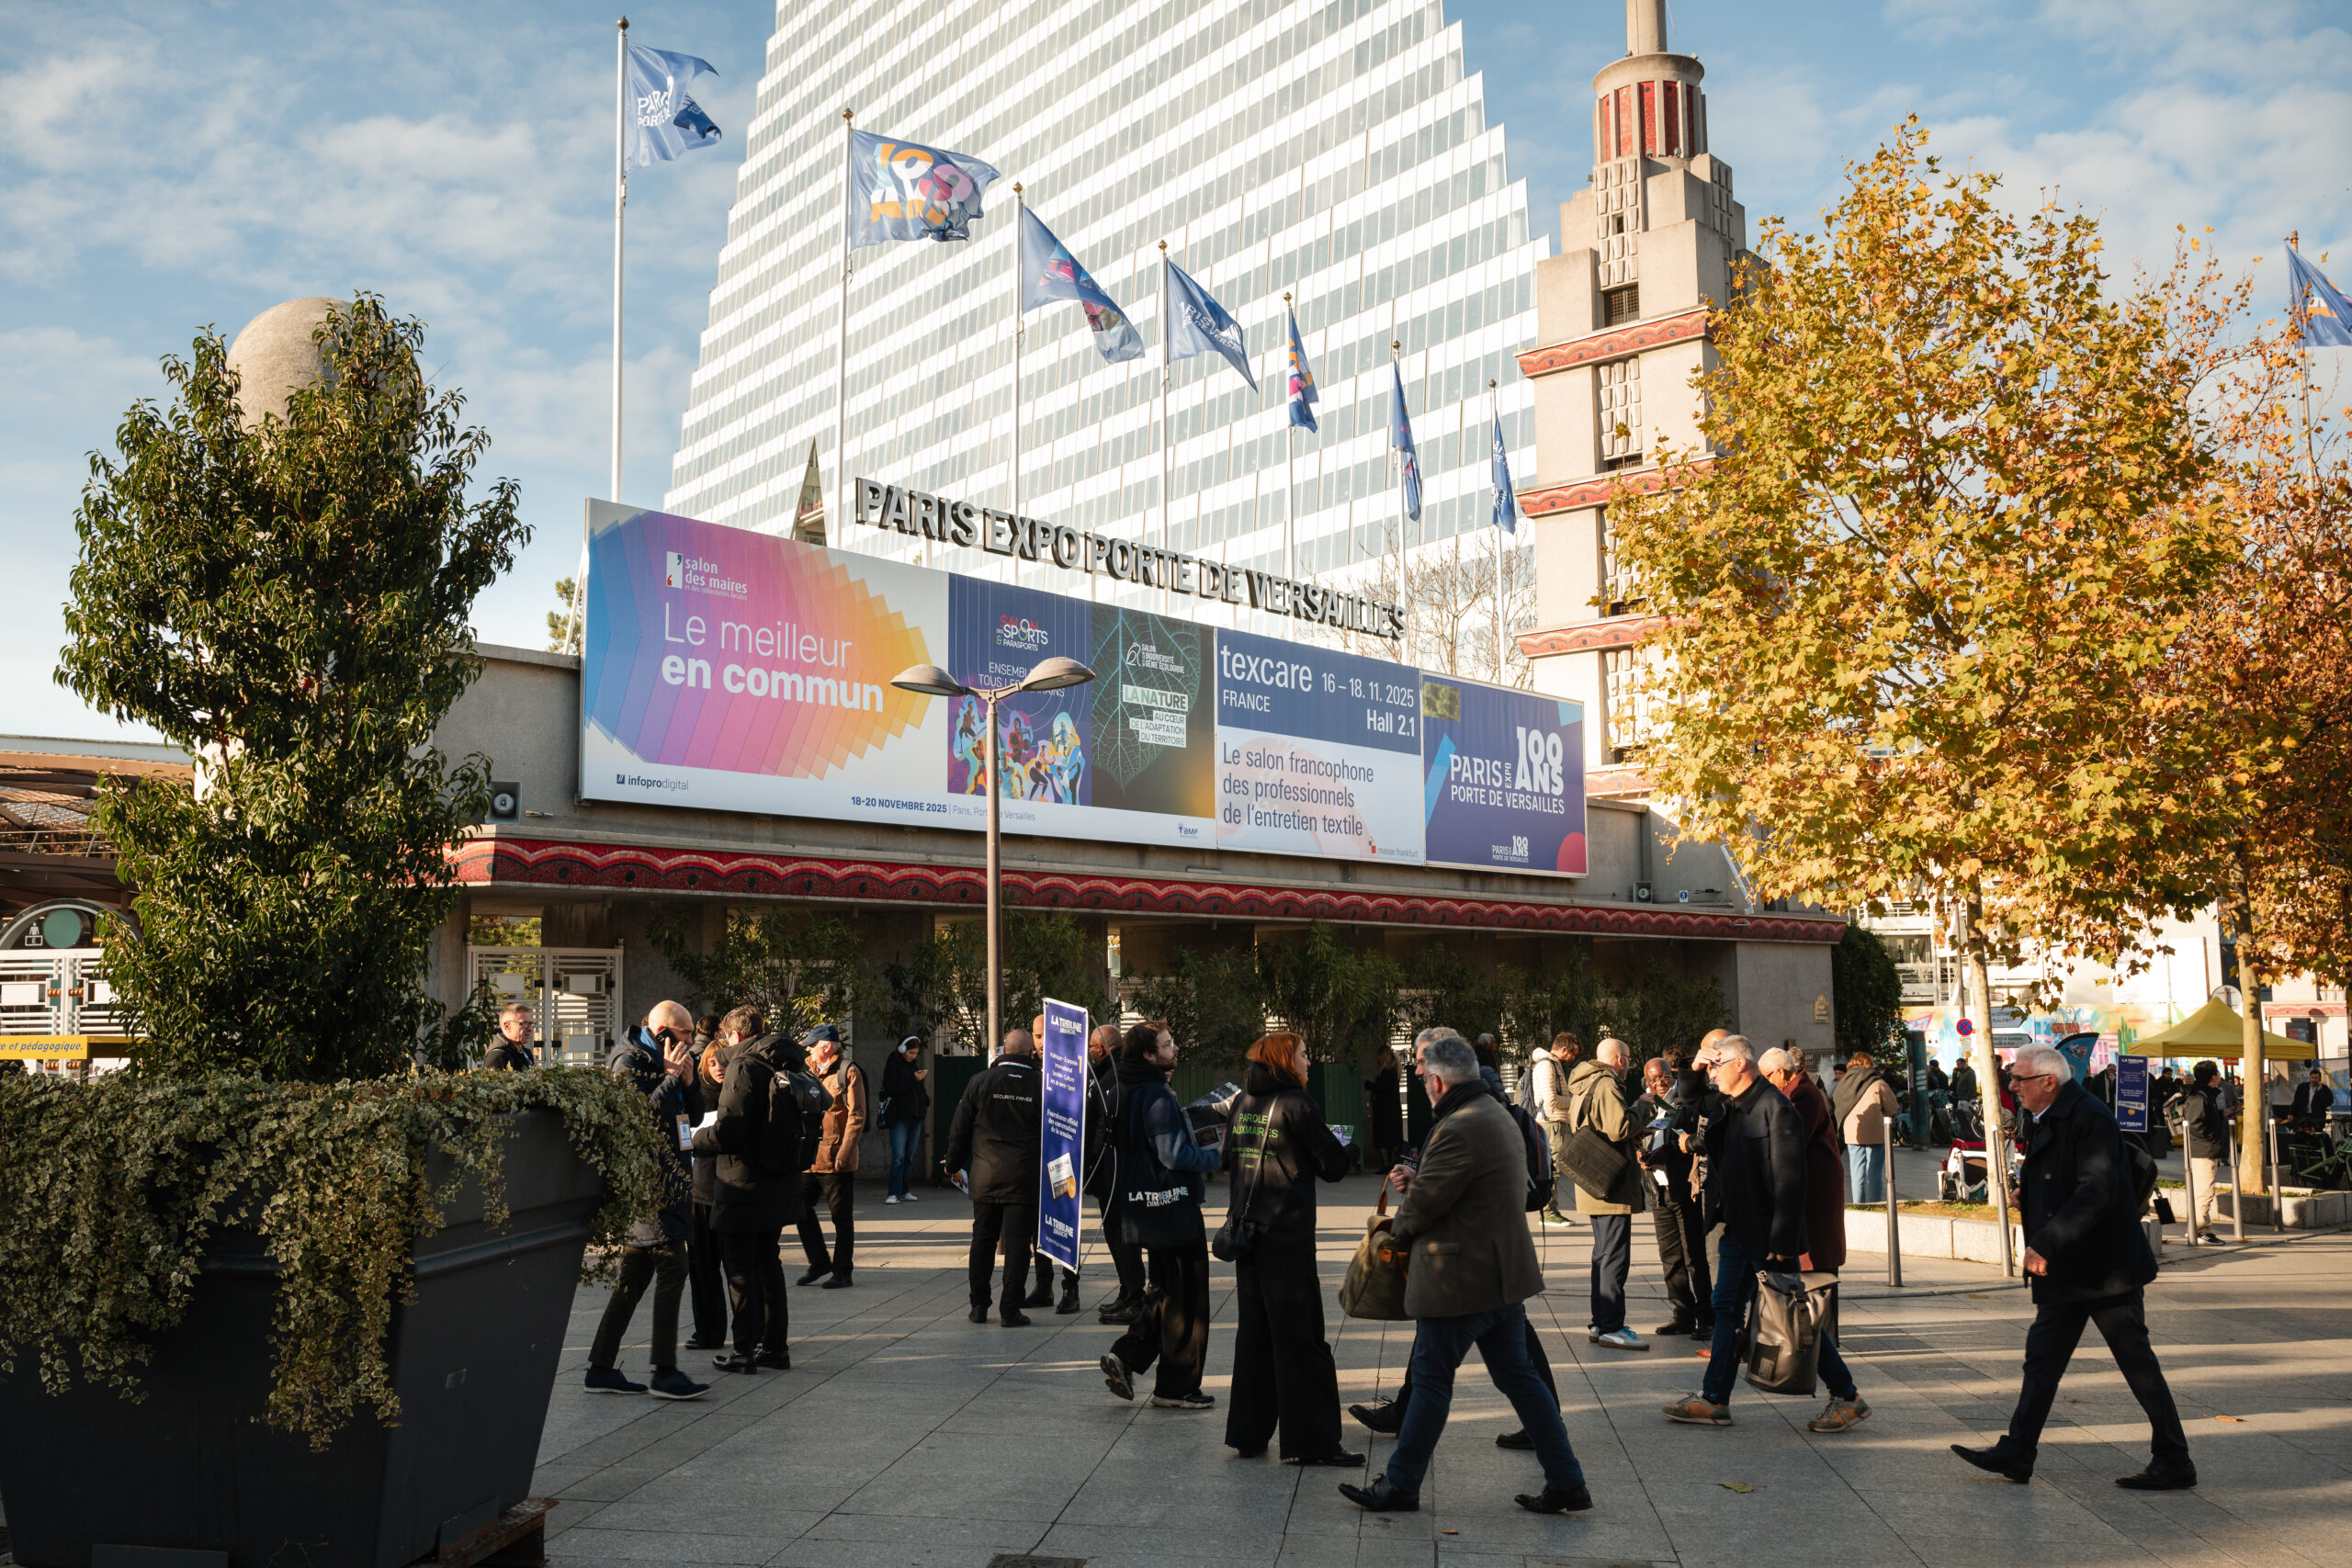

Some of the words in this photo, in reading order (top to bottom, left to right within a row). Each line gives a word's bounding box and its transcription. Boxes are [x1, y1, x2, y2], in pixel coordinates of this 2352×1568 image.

[685, 557, 718, 574] salon
[856, 477, 978, 547] PARIS
[983, 507, 1081, 569] EXPO
[1084, 531, 1194, 593] PORTE
[1199, 558, 1247, 604] DE
[1250, 569, 1408, 639] VERSAILLES
[685, 570, 706, 586] des
[709, 578, 748, 594] maires
[1001, 615, 1038, 633] SALON
[1003, 624, 1048, 645] SPORTS
[664, 602, 707, 646] Le
[721, 620, 852, 669] meilleur
[1003, 638, 1038, 651] PARASPORTS
[1141, 643, 1156, 653] SALON
[662, 654, 711, 690] en
[723, 663, 883, 713] commun
[978, 673, 1001, 688] TOUS
[1220, 645, 1313, 693] texcare
[1322, 672, 1336, 694] 16
[1350, 678, 1365, 699] 18.
[1369, 682, 1382, 702] 11.
[1385, 684, 1415, 707] 2025
[1125, 686, 1138, 701] LA
[1141, 689, 1186, 710] NATURE
[1154, 713, 1164, 722] AU
[1164, 714, 1184, 725] CŒUR
[1223, 689, 1271, 713] FRANCE
[1366, 709, 1393, 736] Hall
[1397, 715, 1415, 737] 2.1
[1131, 719, 1139, 728] DE
[1141, 721, 1185, 735] L'ADAPTATION
[1141, 732, 1150, 741] DU
[1151, 734, 1185, 747] TERRITOIRE
[1516, 726, 1564, 766] 100
[1223, 741, 1240, 764] Le
[1246, 746, 1284, 772] salon
[1289, 750, 1374, 784] francophone
[1450, 753, 1503, 787] PARIS
[1504, 762, 1512, 789] EXPO
[628, 774, 689, 791] infoprodigital
[1514, 757, 1564, 796] ANS
[1223, 772, 1249, 797] des
[1254, 777, 1355, 808] professionnels
[1451, 784, 1487, 805] PORTE
[1488, 789, 1503, 807] DE
[1506, 792, 1565, 815] VERSAILLES
[851, 796, 876, 807] 18-20
[878, 798, 924, 811] NOVEMBRE
[926, 803, 947, 813] 2025
[953, 805, 972, 816] Paris,
[1004, 810, 1035, 820] Versailles
[1223, 801, 1241, 825] de
[1247, 805, 1317, 832] l'entretien
[1322, 813, 1363, 837] textile
[1492, 845, 1509, 855] PARIS
[1051, 1015, 1059, 1026] LA
[1059, 1017, 1082, 1033] TRIBUNE
[9, 1042, 18, 1050] et
[19, 1041, 83, 1053] pédagogique.
[1239, 1112, 1268, 1124] PAROLE
[1232, 1125, 1245, 1134] AUX
[1128, 1191, 1144, 1201] LA
[1145, 1186, 1189, 1201] TRIBUNE
[1147, 1194, 1180, 1207] DIMANCHE
[1045, 1214, 1053, 1226] LA
[1053, 1217, 1074, 1238] TRIBUNE
